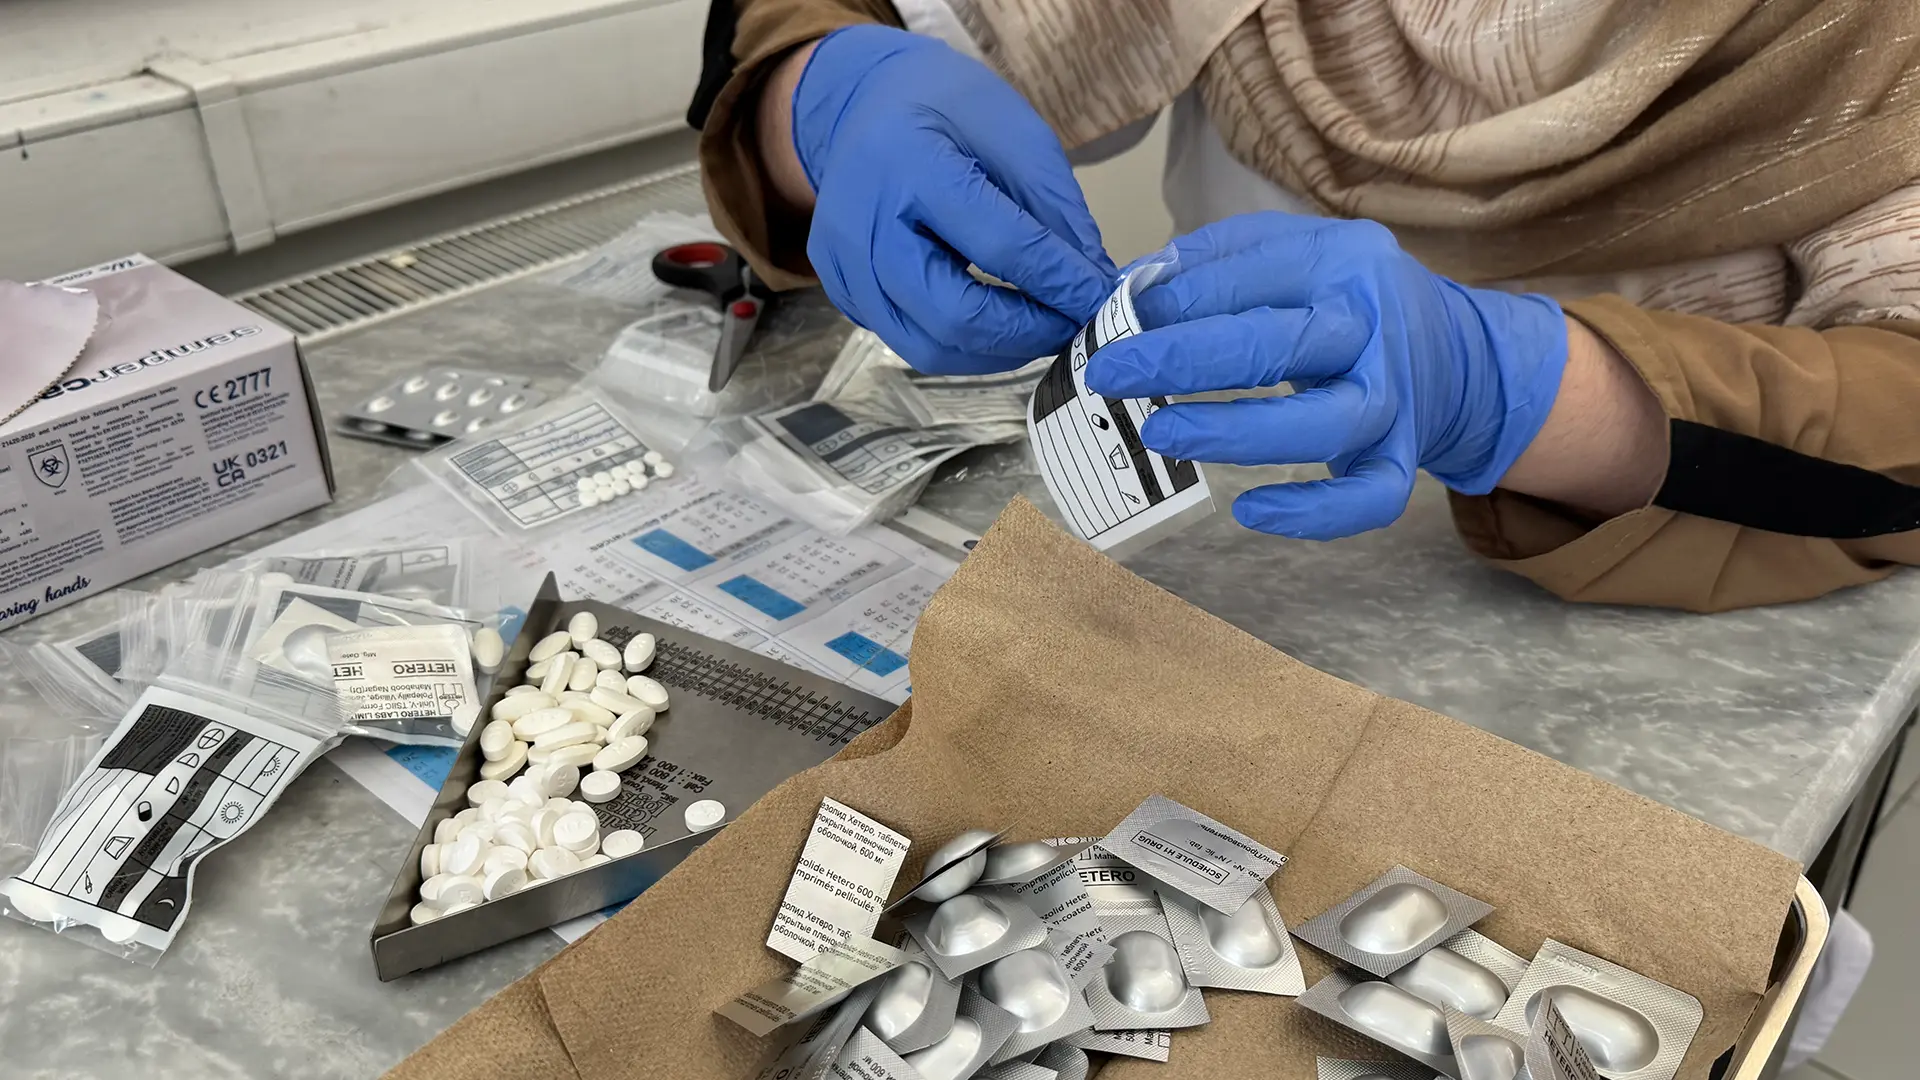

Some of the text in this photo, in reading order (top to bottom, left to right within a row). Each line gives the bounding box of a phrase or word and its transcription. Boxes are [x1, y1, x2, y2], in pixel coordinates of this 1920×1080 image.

[227, 367, 272, 400] 2777
[213, 456, 242, 475] UK
[217, 441, 289, 488] CA 0321
[45, 577, 91, 603] hands
[332, 660, 455, 677] HETERO HET
[390, 682, 431, 692] Mahaboob
[398, 690, 432, 700] Polepally
[374, 710, 398, 718] LABS
[400, 708, 435, 717] HETERO
[845, 814, 878, 837] Хетеро,
[815, 824, 885, 865] оболочкой, 600 мг
[853, 830, 895, 857] пленочной
[1138, 835, 1223, 880] SCHEDULE H1 DRUG
[797, 854, 826, 875] zolide
[825, 868, 857, 890] Hetero
[855, 884, 874, 899] 600
[794, 866, 876, 914] mprimés pelliculés
[1033, 884, 1049, 895] con
[804, 911, 836, 933] Хетеро,
[772, 921, 818, 951] оболочкой,
[868, 1061, 886, 1078] 600
